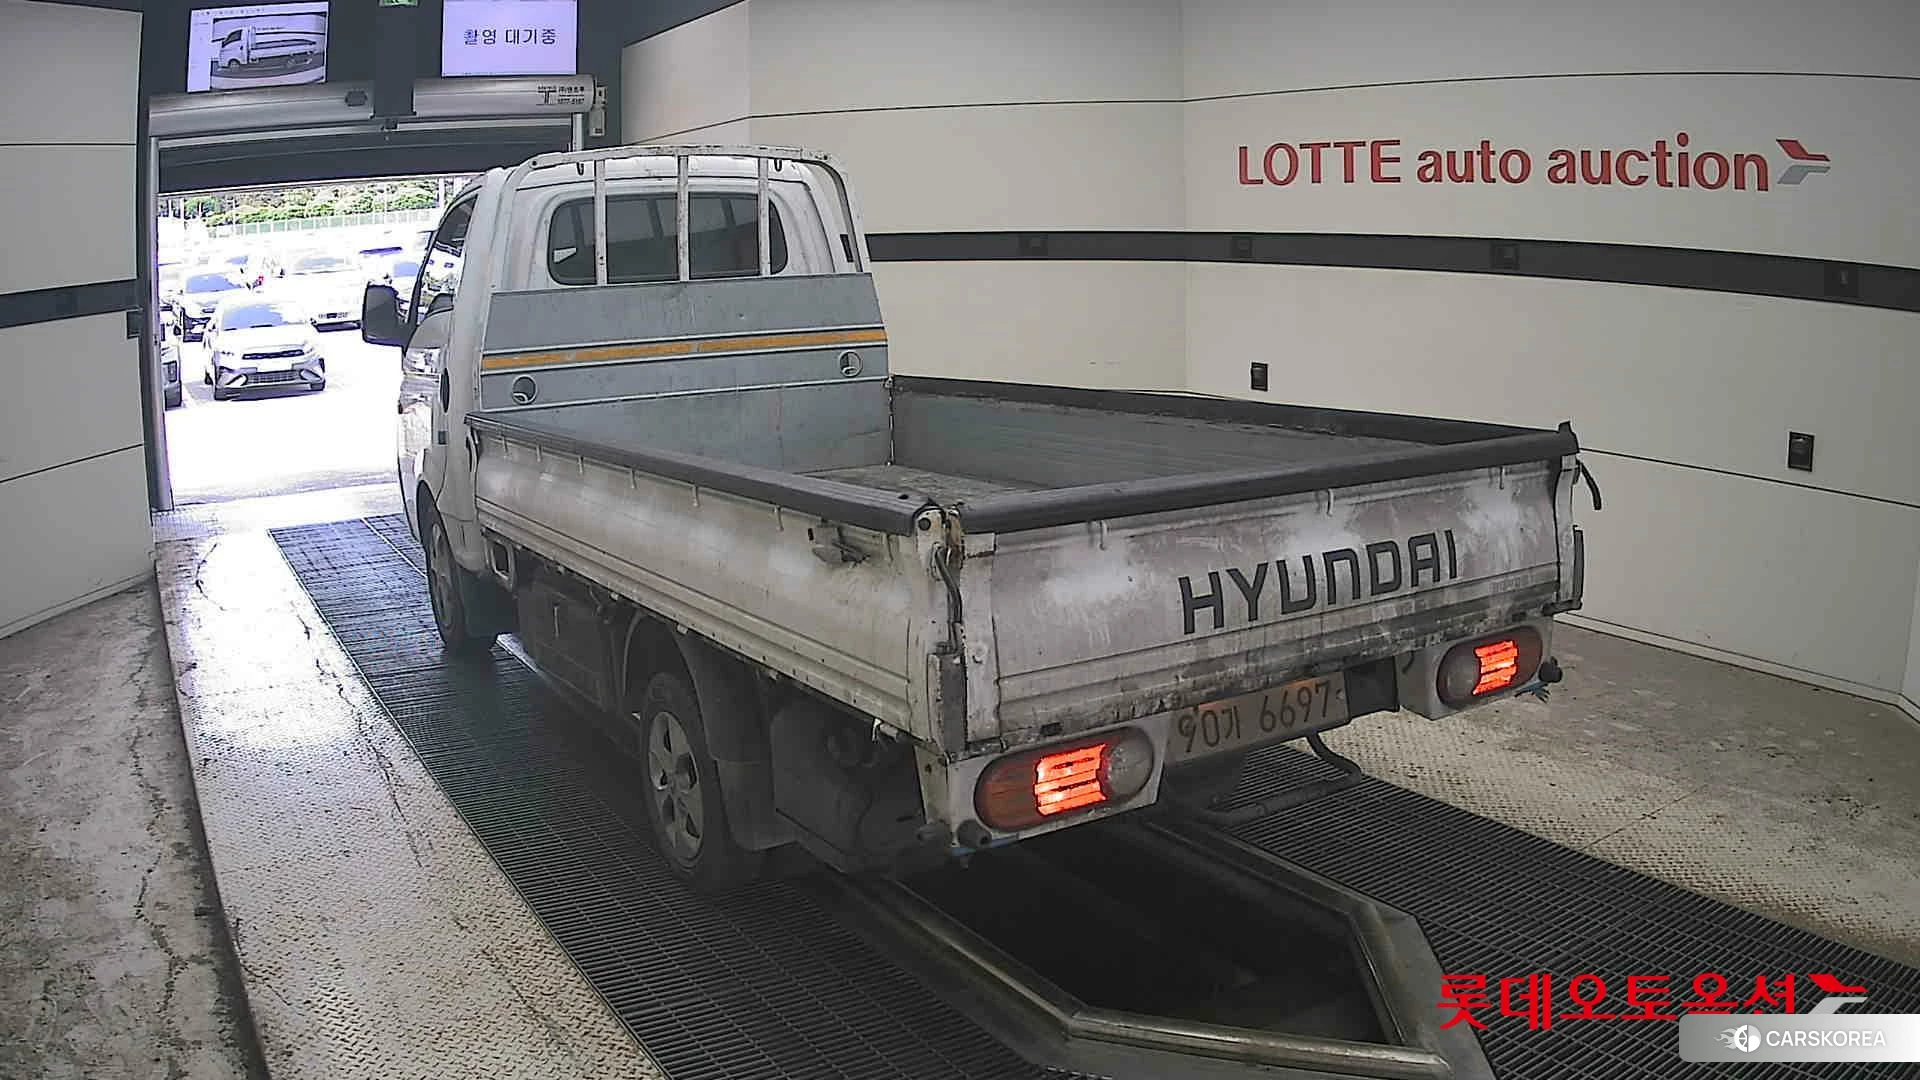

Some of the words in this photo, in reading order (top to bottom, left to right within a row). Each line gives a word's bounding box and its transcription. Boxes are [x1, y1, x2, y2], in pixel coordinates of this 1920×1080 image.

[463, 28, 497, 46] 촬영
[505, 28, 556, 45] 대기중
[1239, 139, 1401, 185] LOTTE
[1416, 139, 1532, 184] auto
[1547, 132, 1769, 192] auction
[1178, 529, 1458, 635] HYUNDAI
[1260, 680, 1331, 733] 6697
